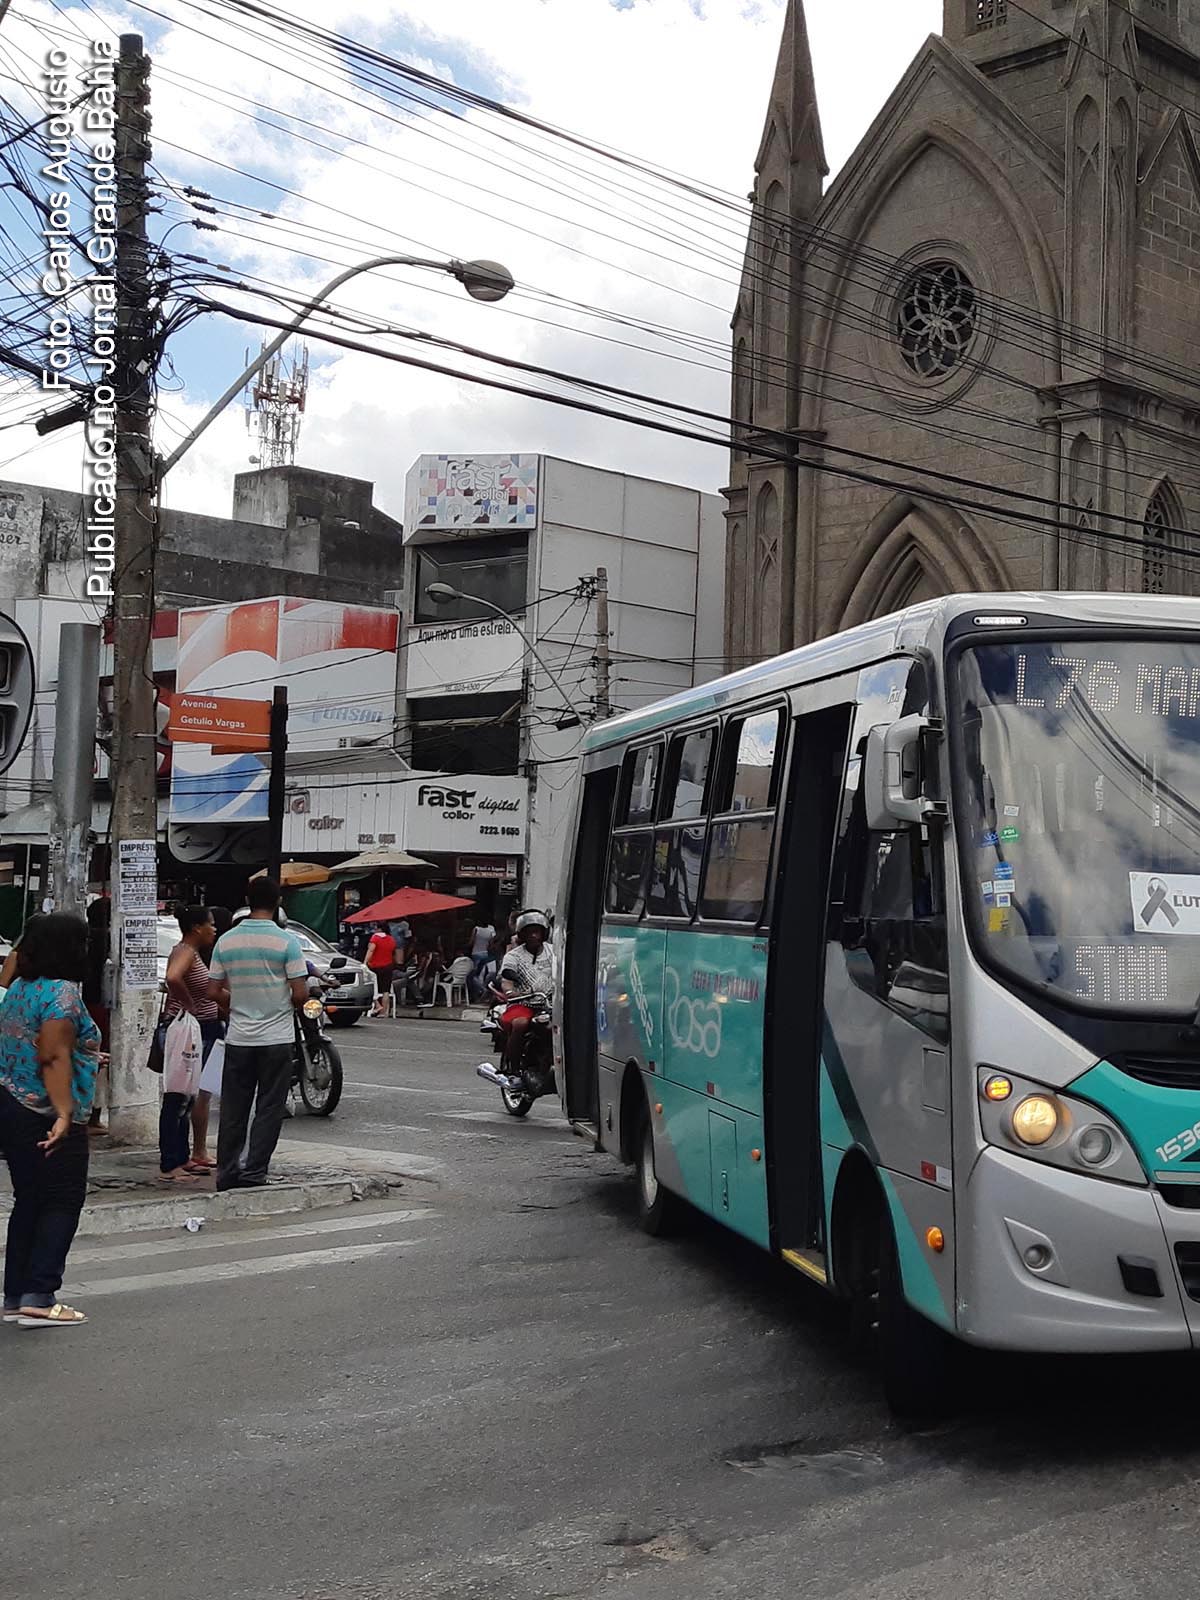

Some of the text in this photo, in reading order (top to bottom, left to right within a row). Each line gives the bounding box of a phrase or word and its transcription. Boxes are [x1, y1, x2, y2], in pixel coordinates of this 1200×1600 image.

[460, 626, 479, 638] uma
[1015, 653, 1122, 713] L76
[181, 698, 218, 711] Avenida
[215, 717, 246, 730] Vargas
[418, 784, 477, 809] fast
[478, 796, 521, 815] digital
